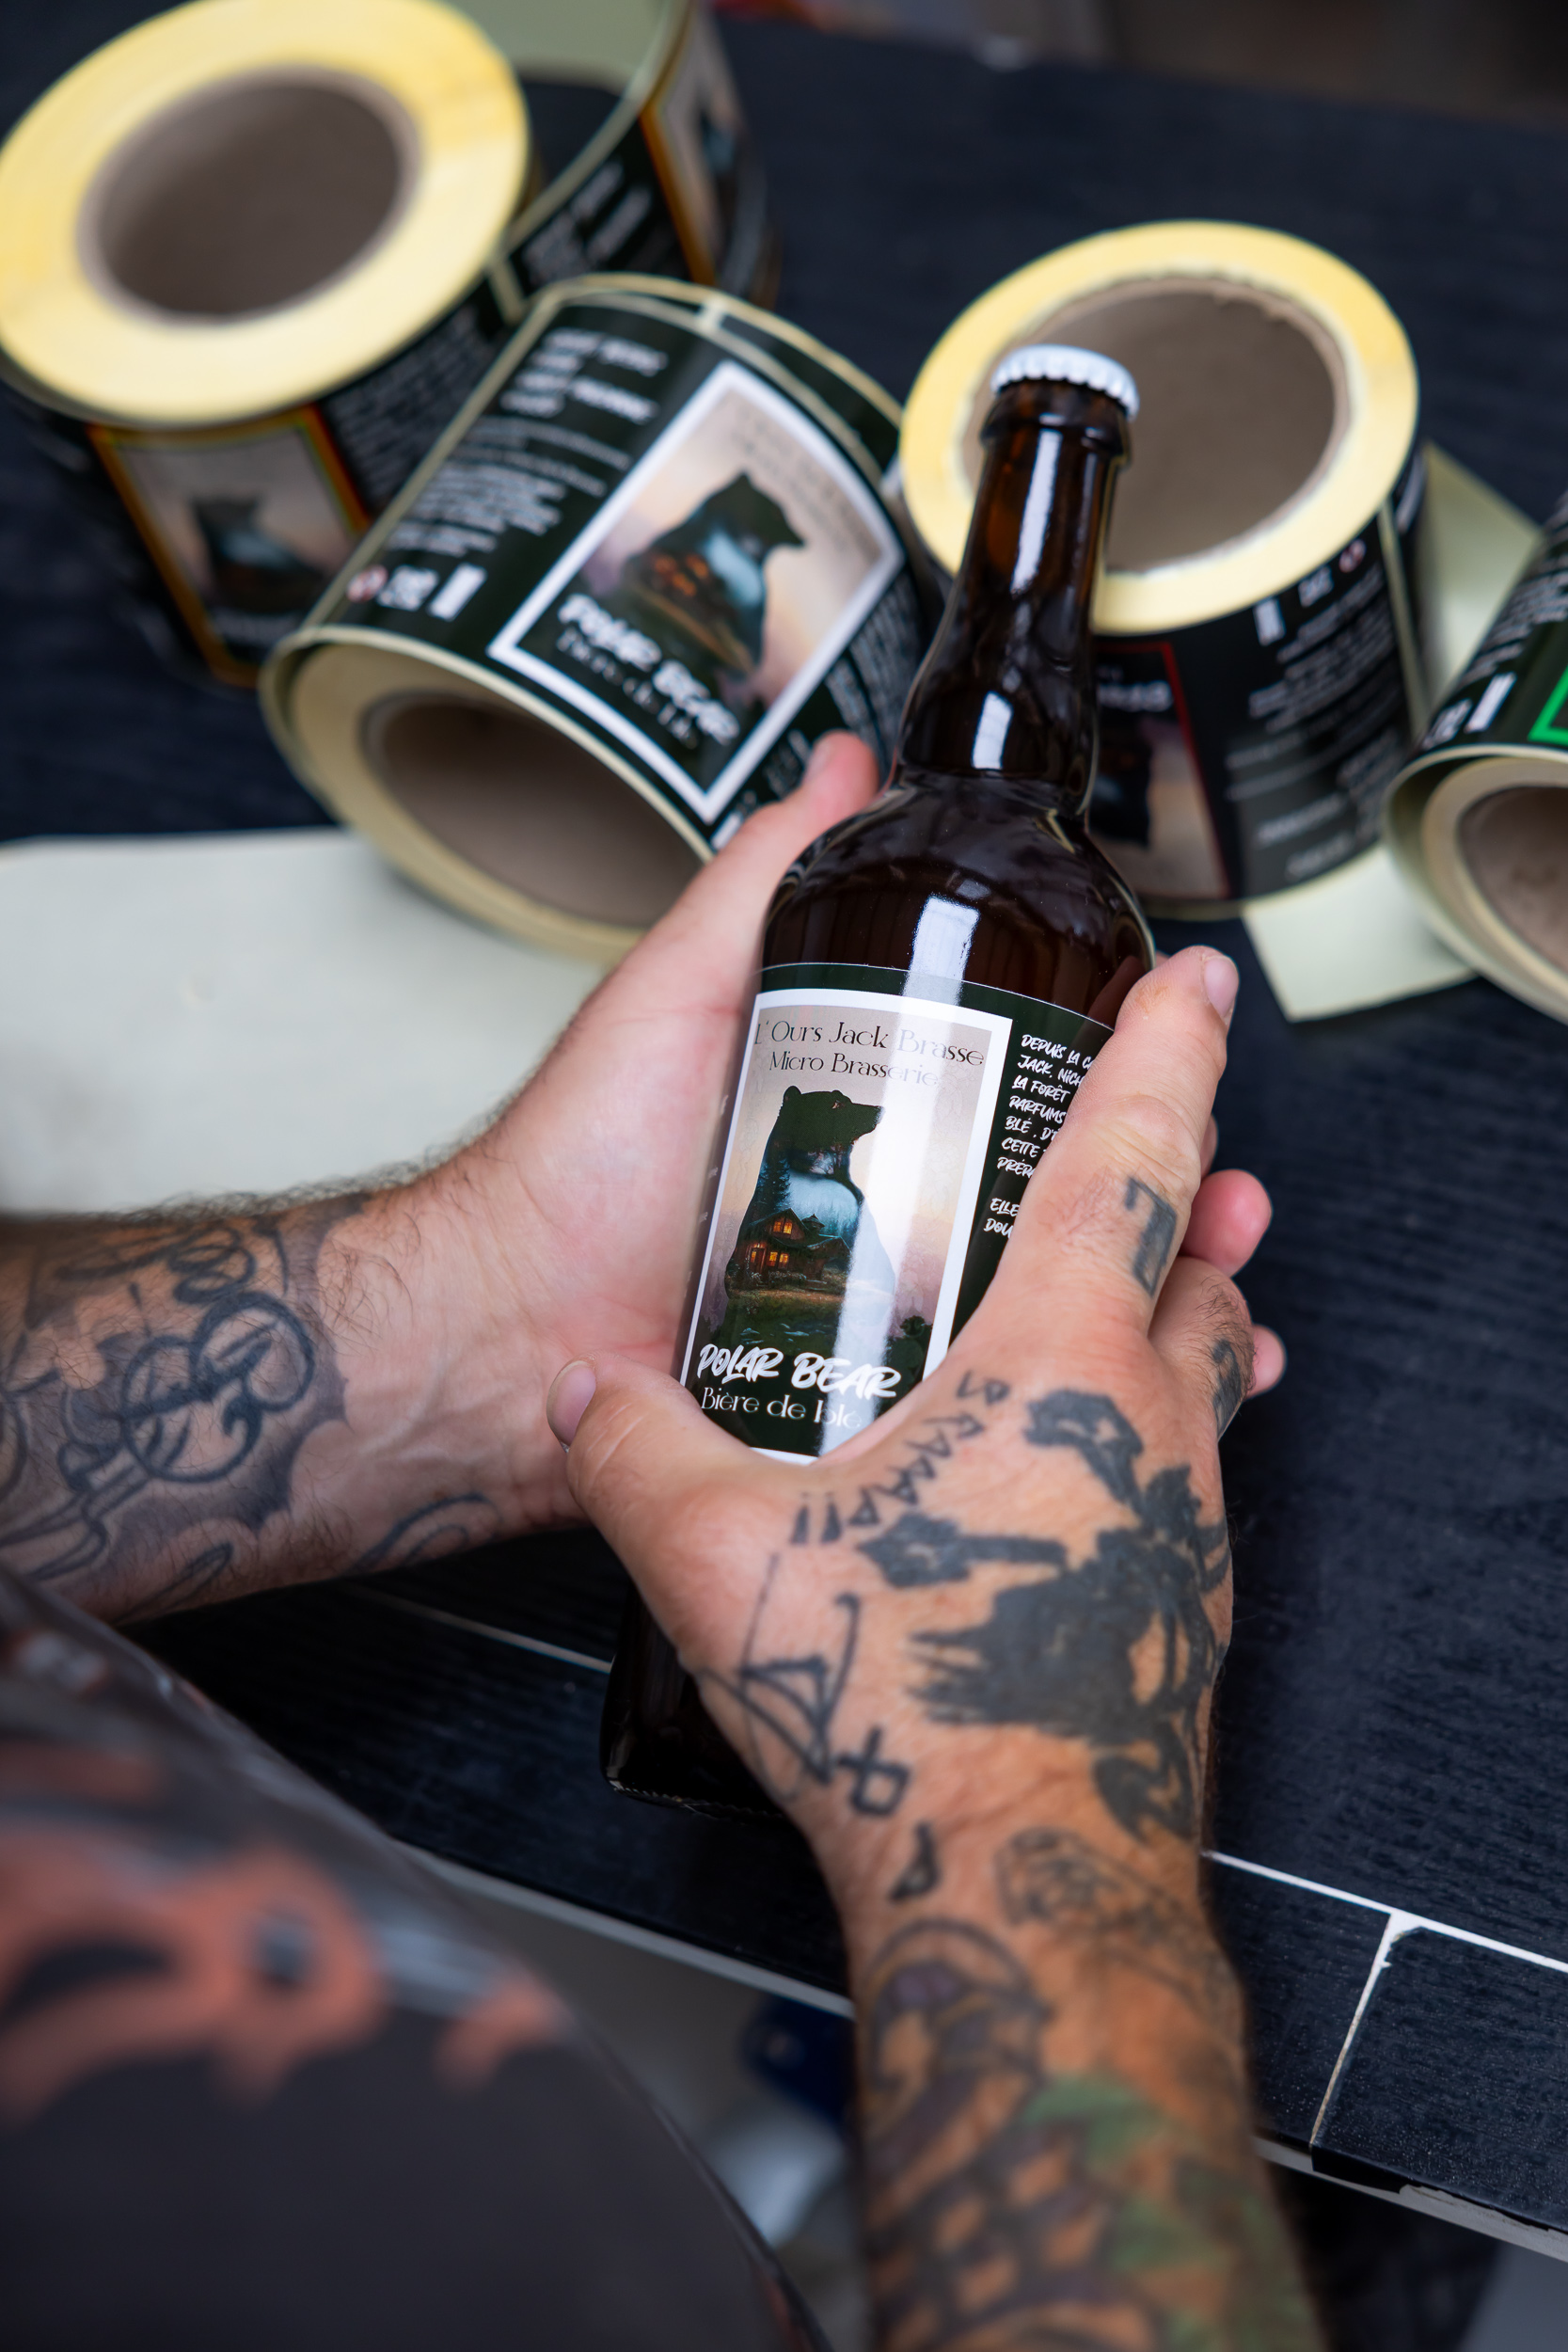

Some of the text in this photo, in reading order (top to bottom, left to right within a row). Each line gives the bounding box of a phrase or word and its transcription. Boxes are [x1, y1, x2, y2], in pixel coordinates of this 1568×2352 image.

[829, 1022, 889, 1048] Jack
[896, 1028, 985, 1066] Brasse
[1067, 1050, 1081, 1065] LA
[769, 1051, 939, 1086] Micro Brasserie
[1011, 1074, 1070, 1103] LA FORÊT
[1008, 1095, 1067, 1124] PARFUMS
[1005, 1116, 1032, 1134] BLÉ
[1001, 1136, 1040, 1158] CETTE
[990, 1198, 1020, 1217] ELLE
[697, 1343, 902, 1400] POLAR BEAR
[701, 1387, 760, 1412] Bière
[767, 1394, 806, 1420] de
